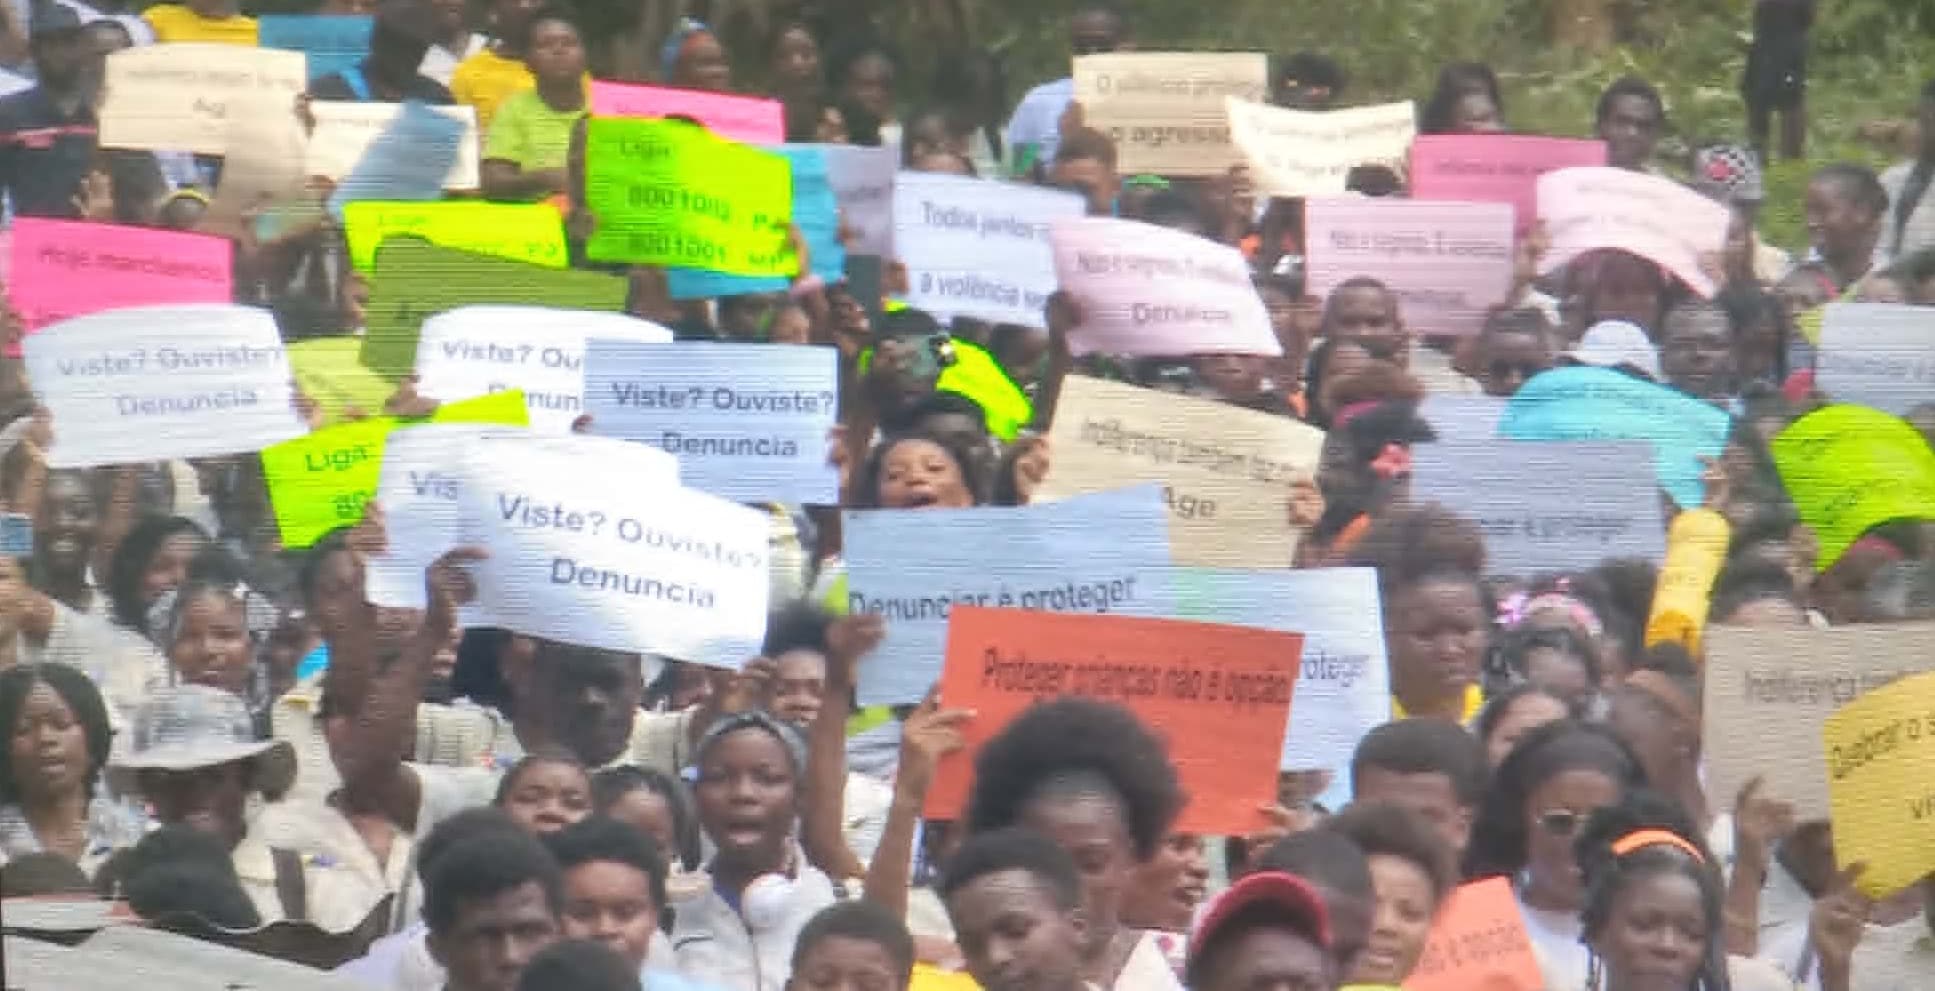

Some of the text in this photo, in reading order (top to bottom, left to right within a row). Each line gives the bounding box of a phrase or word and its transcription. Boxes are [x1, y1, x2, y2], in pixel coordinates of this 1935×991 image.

[57, 349, 146, 376] Viste?
[442, 341, 533, 366] Viste?
[115, 389, 259, 417] Denuncia
[610, 381, 835, 412] Viste? Ouviste?
[662, 431, 799, 457] Denuncia
[499, 492, 763, 570] Viste? Ouviste?
[551, 556, 715, 610] Denuncia
[847, 587, 989, 621] Denunciar
[1018, 573, 1137, 613] proteger
[983, 647, 1071, 703] Proteger
